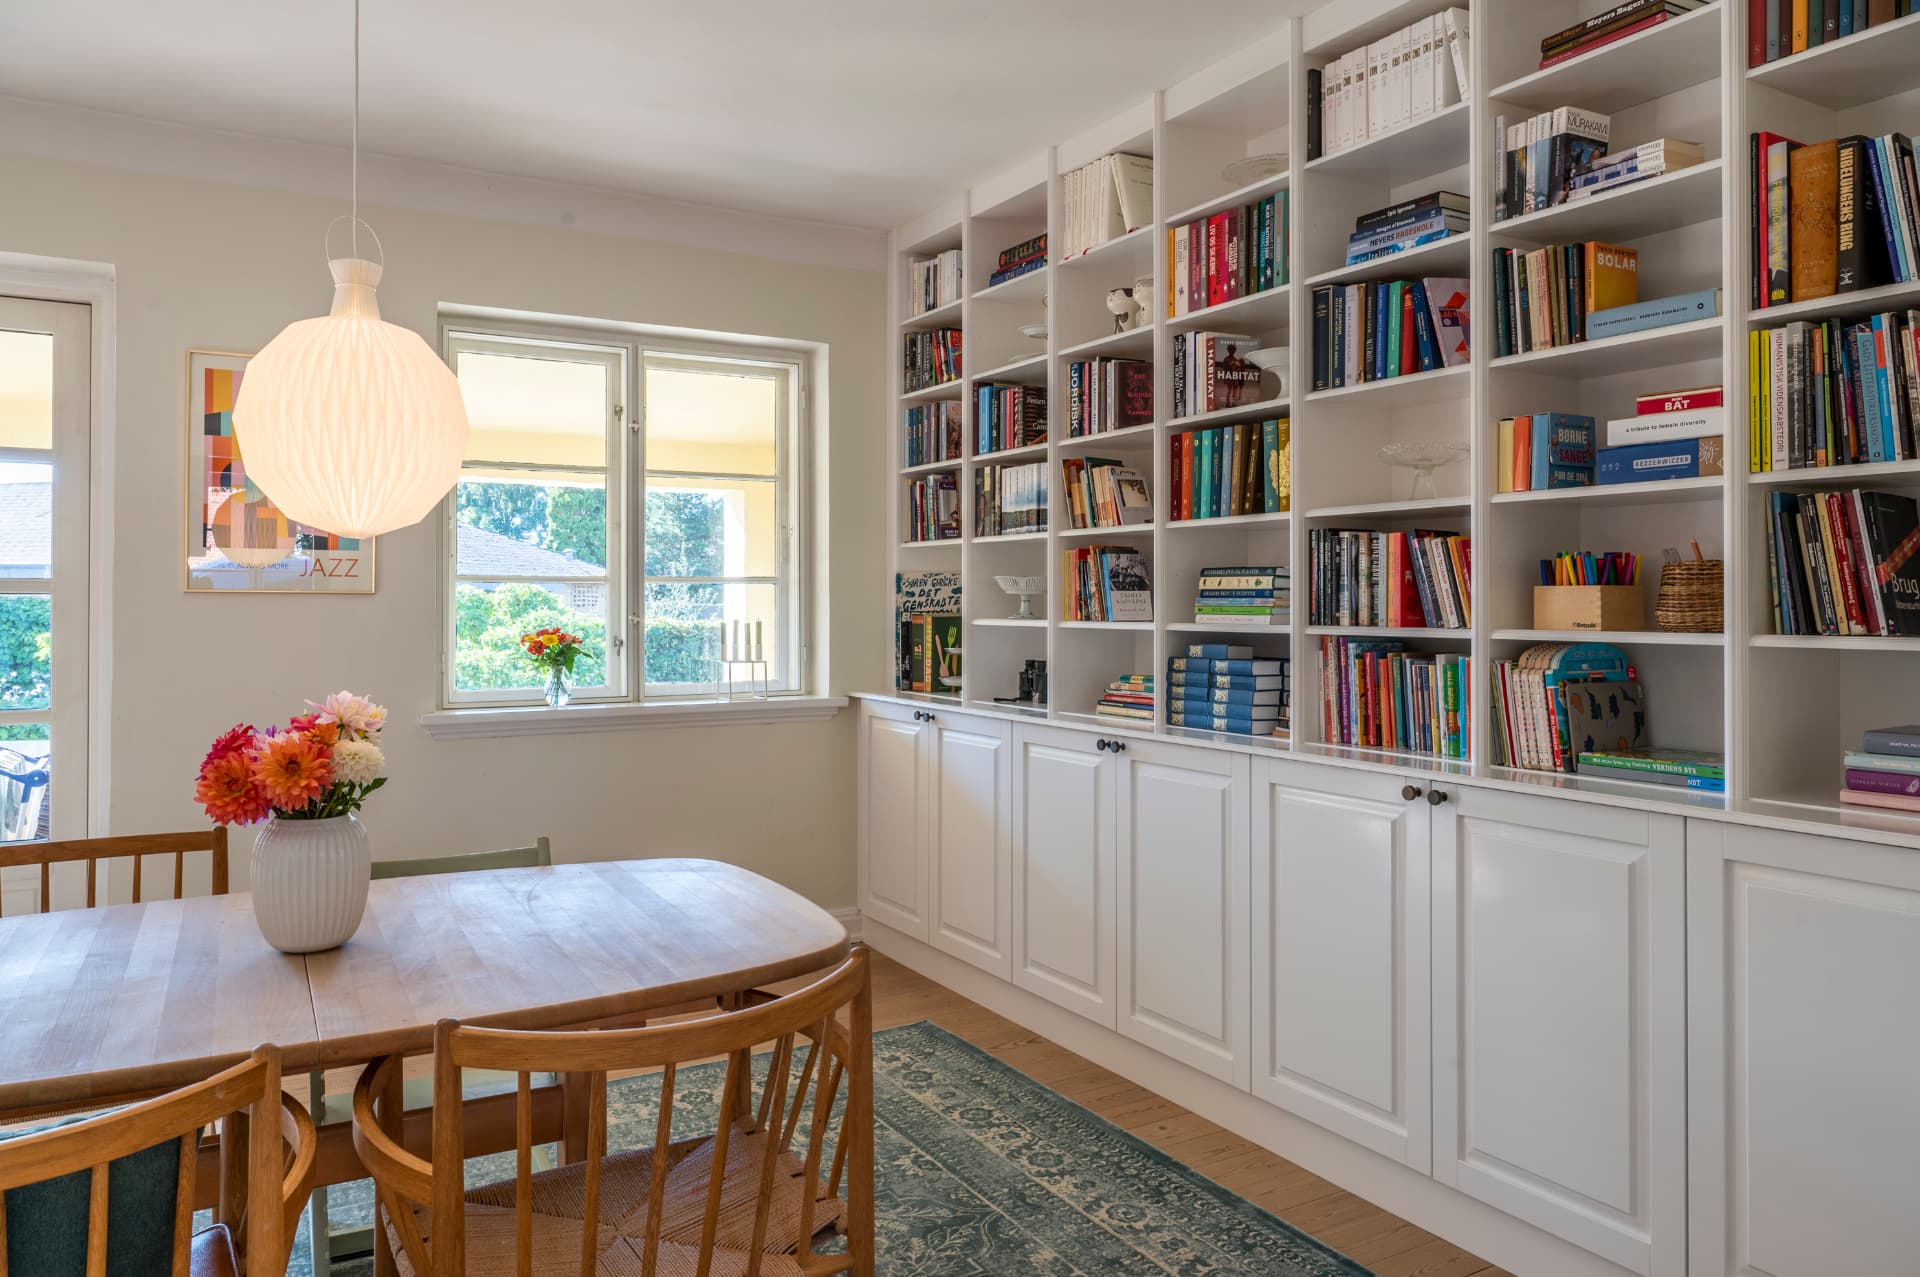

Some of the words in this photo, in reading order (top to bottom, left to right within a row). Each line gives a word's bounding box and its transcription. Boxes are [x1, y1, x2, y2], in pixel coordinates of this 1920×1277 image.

[1568, 115, 1608, 134] MURAKAMI
[1839, 147, 1854, 222] NIBELUNGENS
[1210, 237, 1215, 246] OG
[1370, 233, 1394, 246] MEYERS
[1840, 222, 1854, 251] RING
[1597, 253, 1636, 272] SOLAR
[1776, 333, 1784, 384] HUMANISTISK
[1218, 371, 1260, 381] HABITAT
[1664, 400, 1690, 411] BAT
[1680, 419, 1706, 427] diversity
[1776, 385, 1785, 453] VIDENSKABSTEORI
[1559, 448, 1588, 463] SANGE
[299, 558, 359, 577] JAZZ
[918, 588, 941, 597] DET
